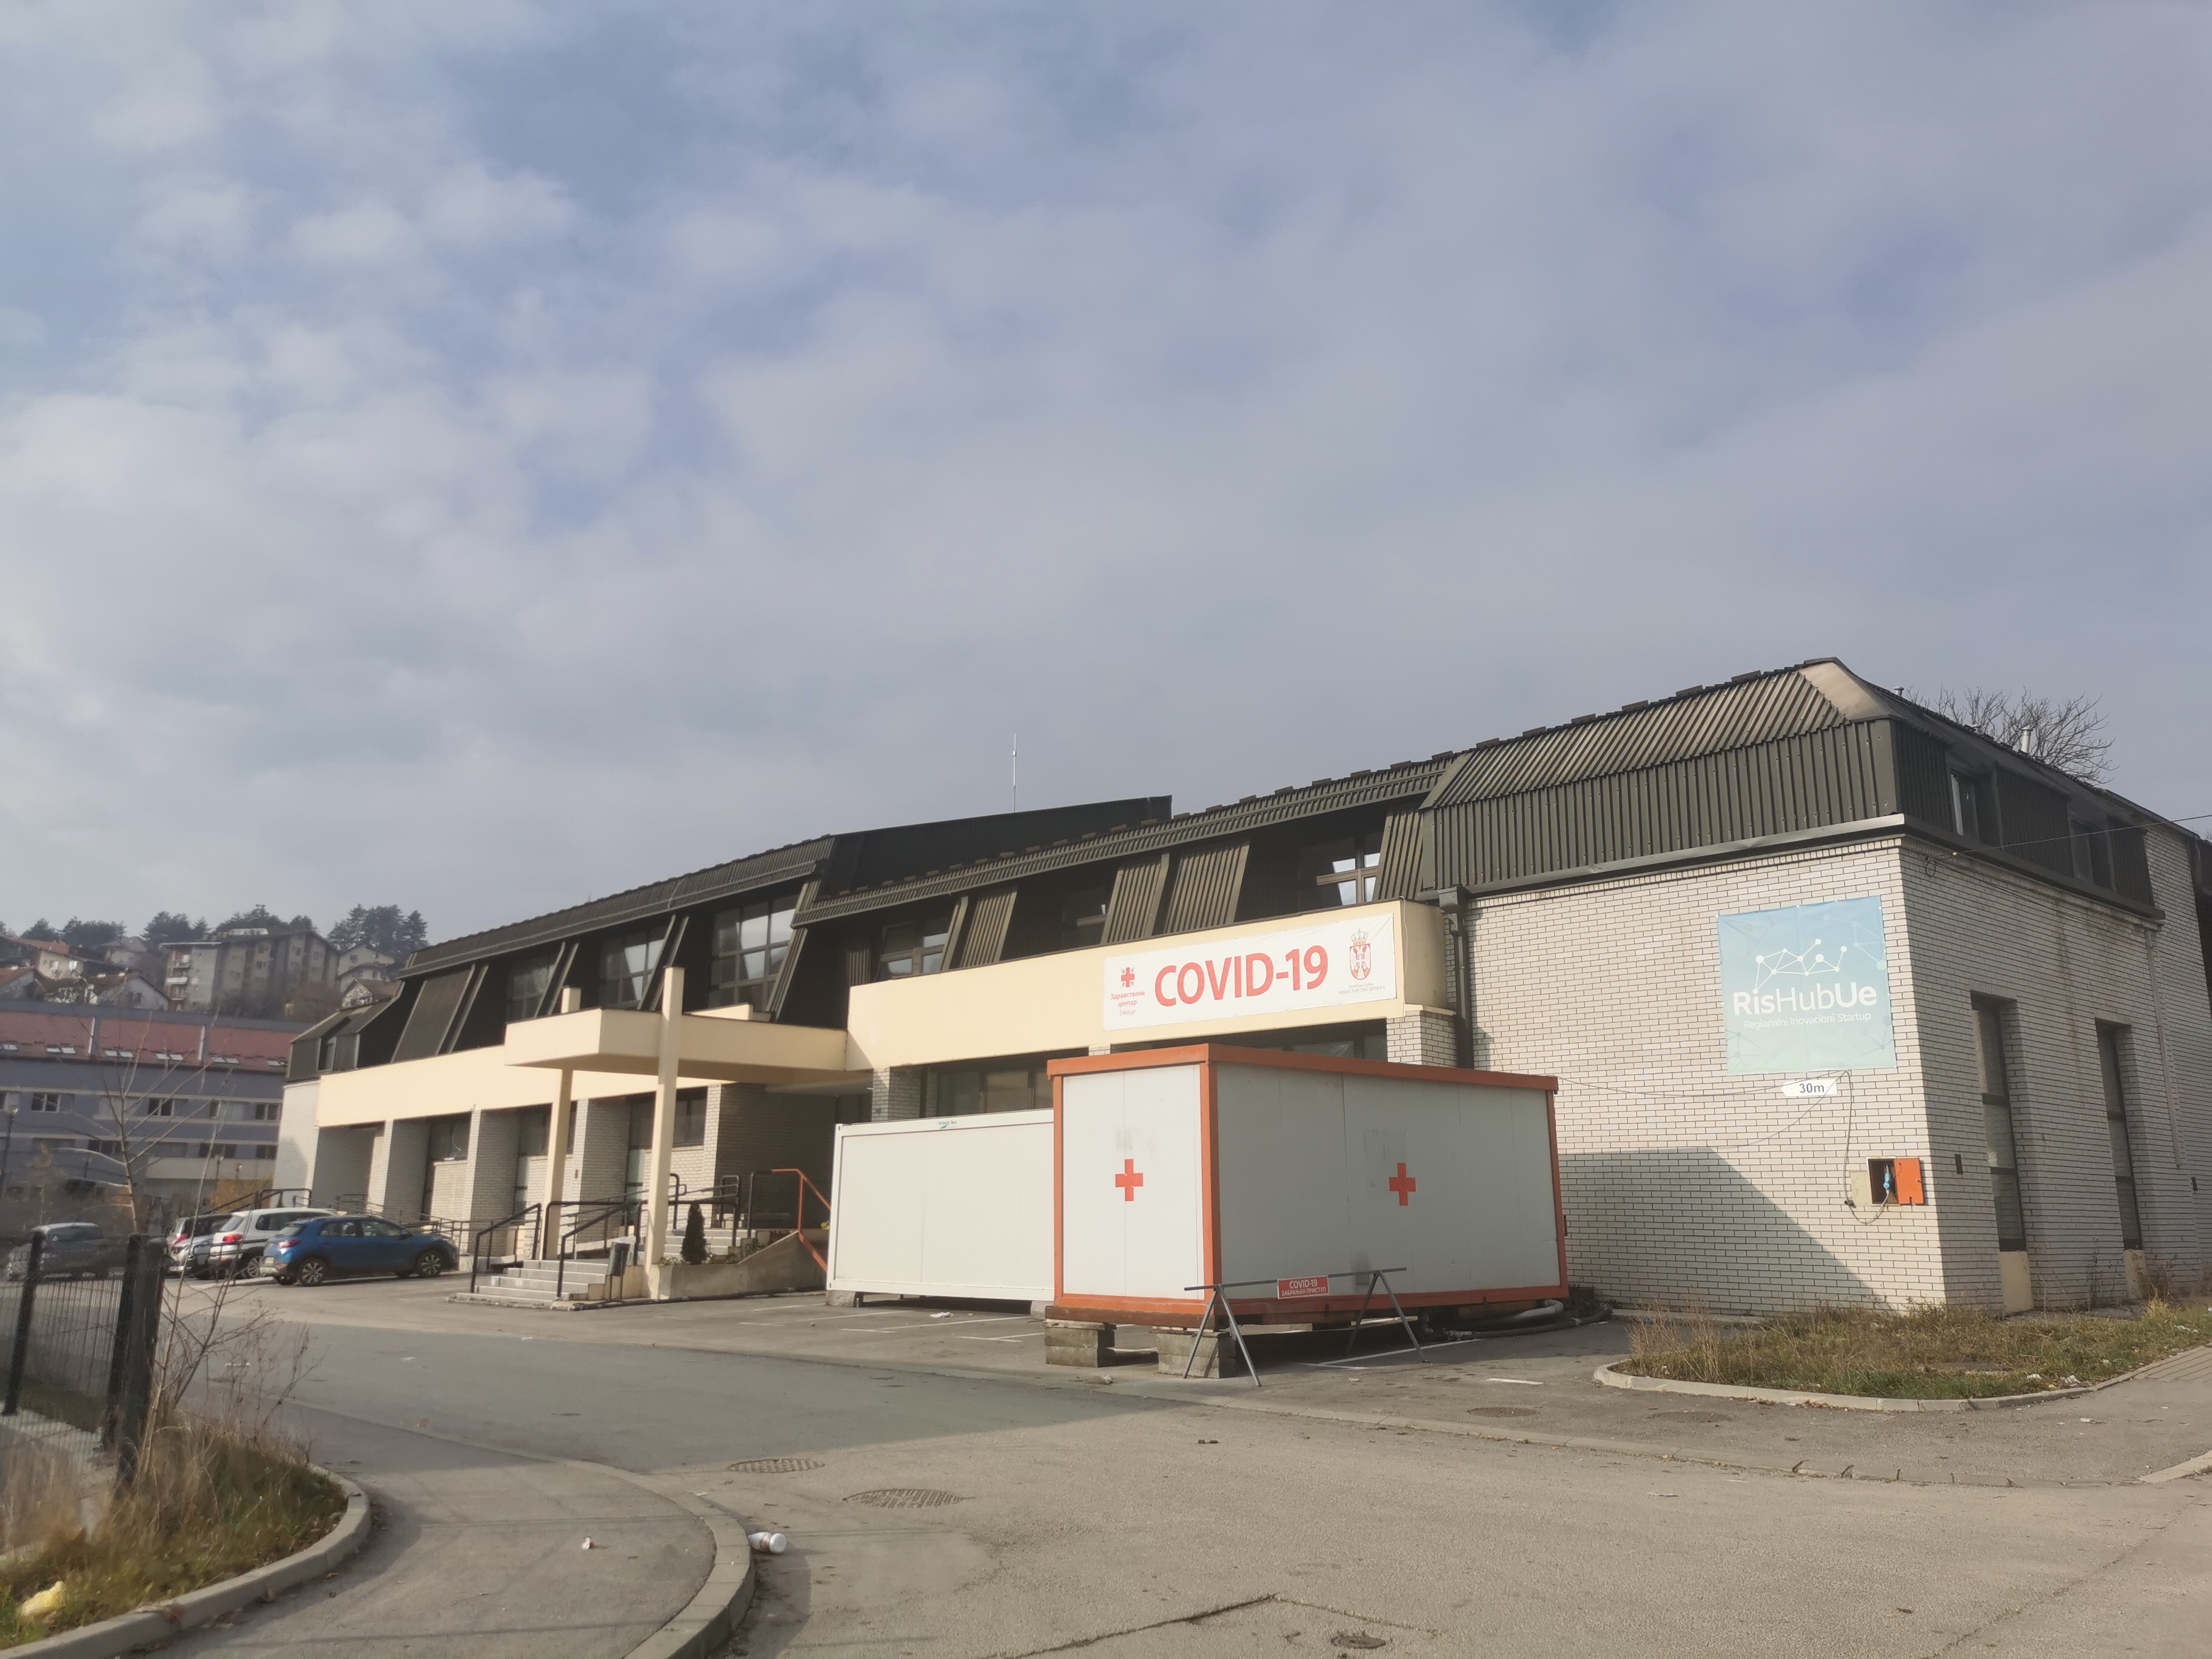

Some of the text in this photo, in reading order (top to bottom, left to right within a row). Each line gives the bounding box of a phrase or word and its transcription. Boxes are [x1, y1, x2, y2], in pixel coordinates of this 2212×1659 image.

[1155, 945, 1329, 1007] COVID-19
[1111, 991, 1145, 1000] Здравствени
[1733, 982, 1877, 1016] RisHubUe
[1744, 1012, 1872, 1030] Regionalni Inovacioni Startup
[1798, 1083, 1825, 1094] 30m
[1289, 1279, 1318, 1289] COVID-19
